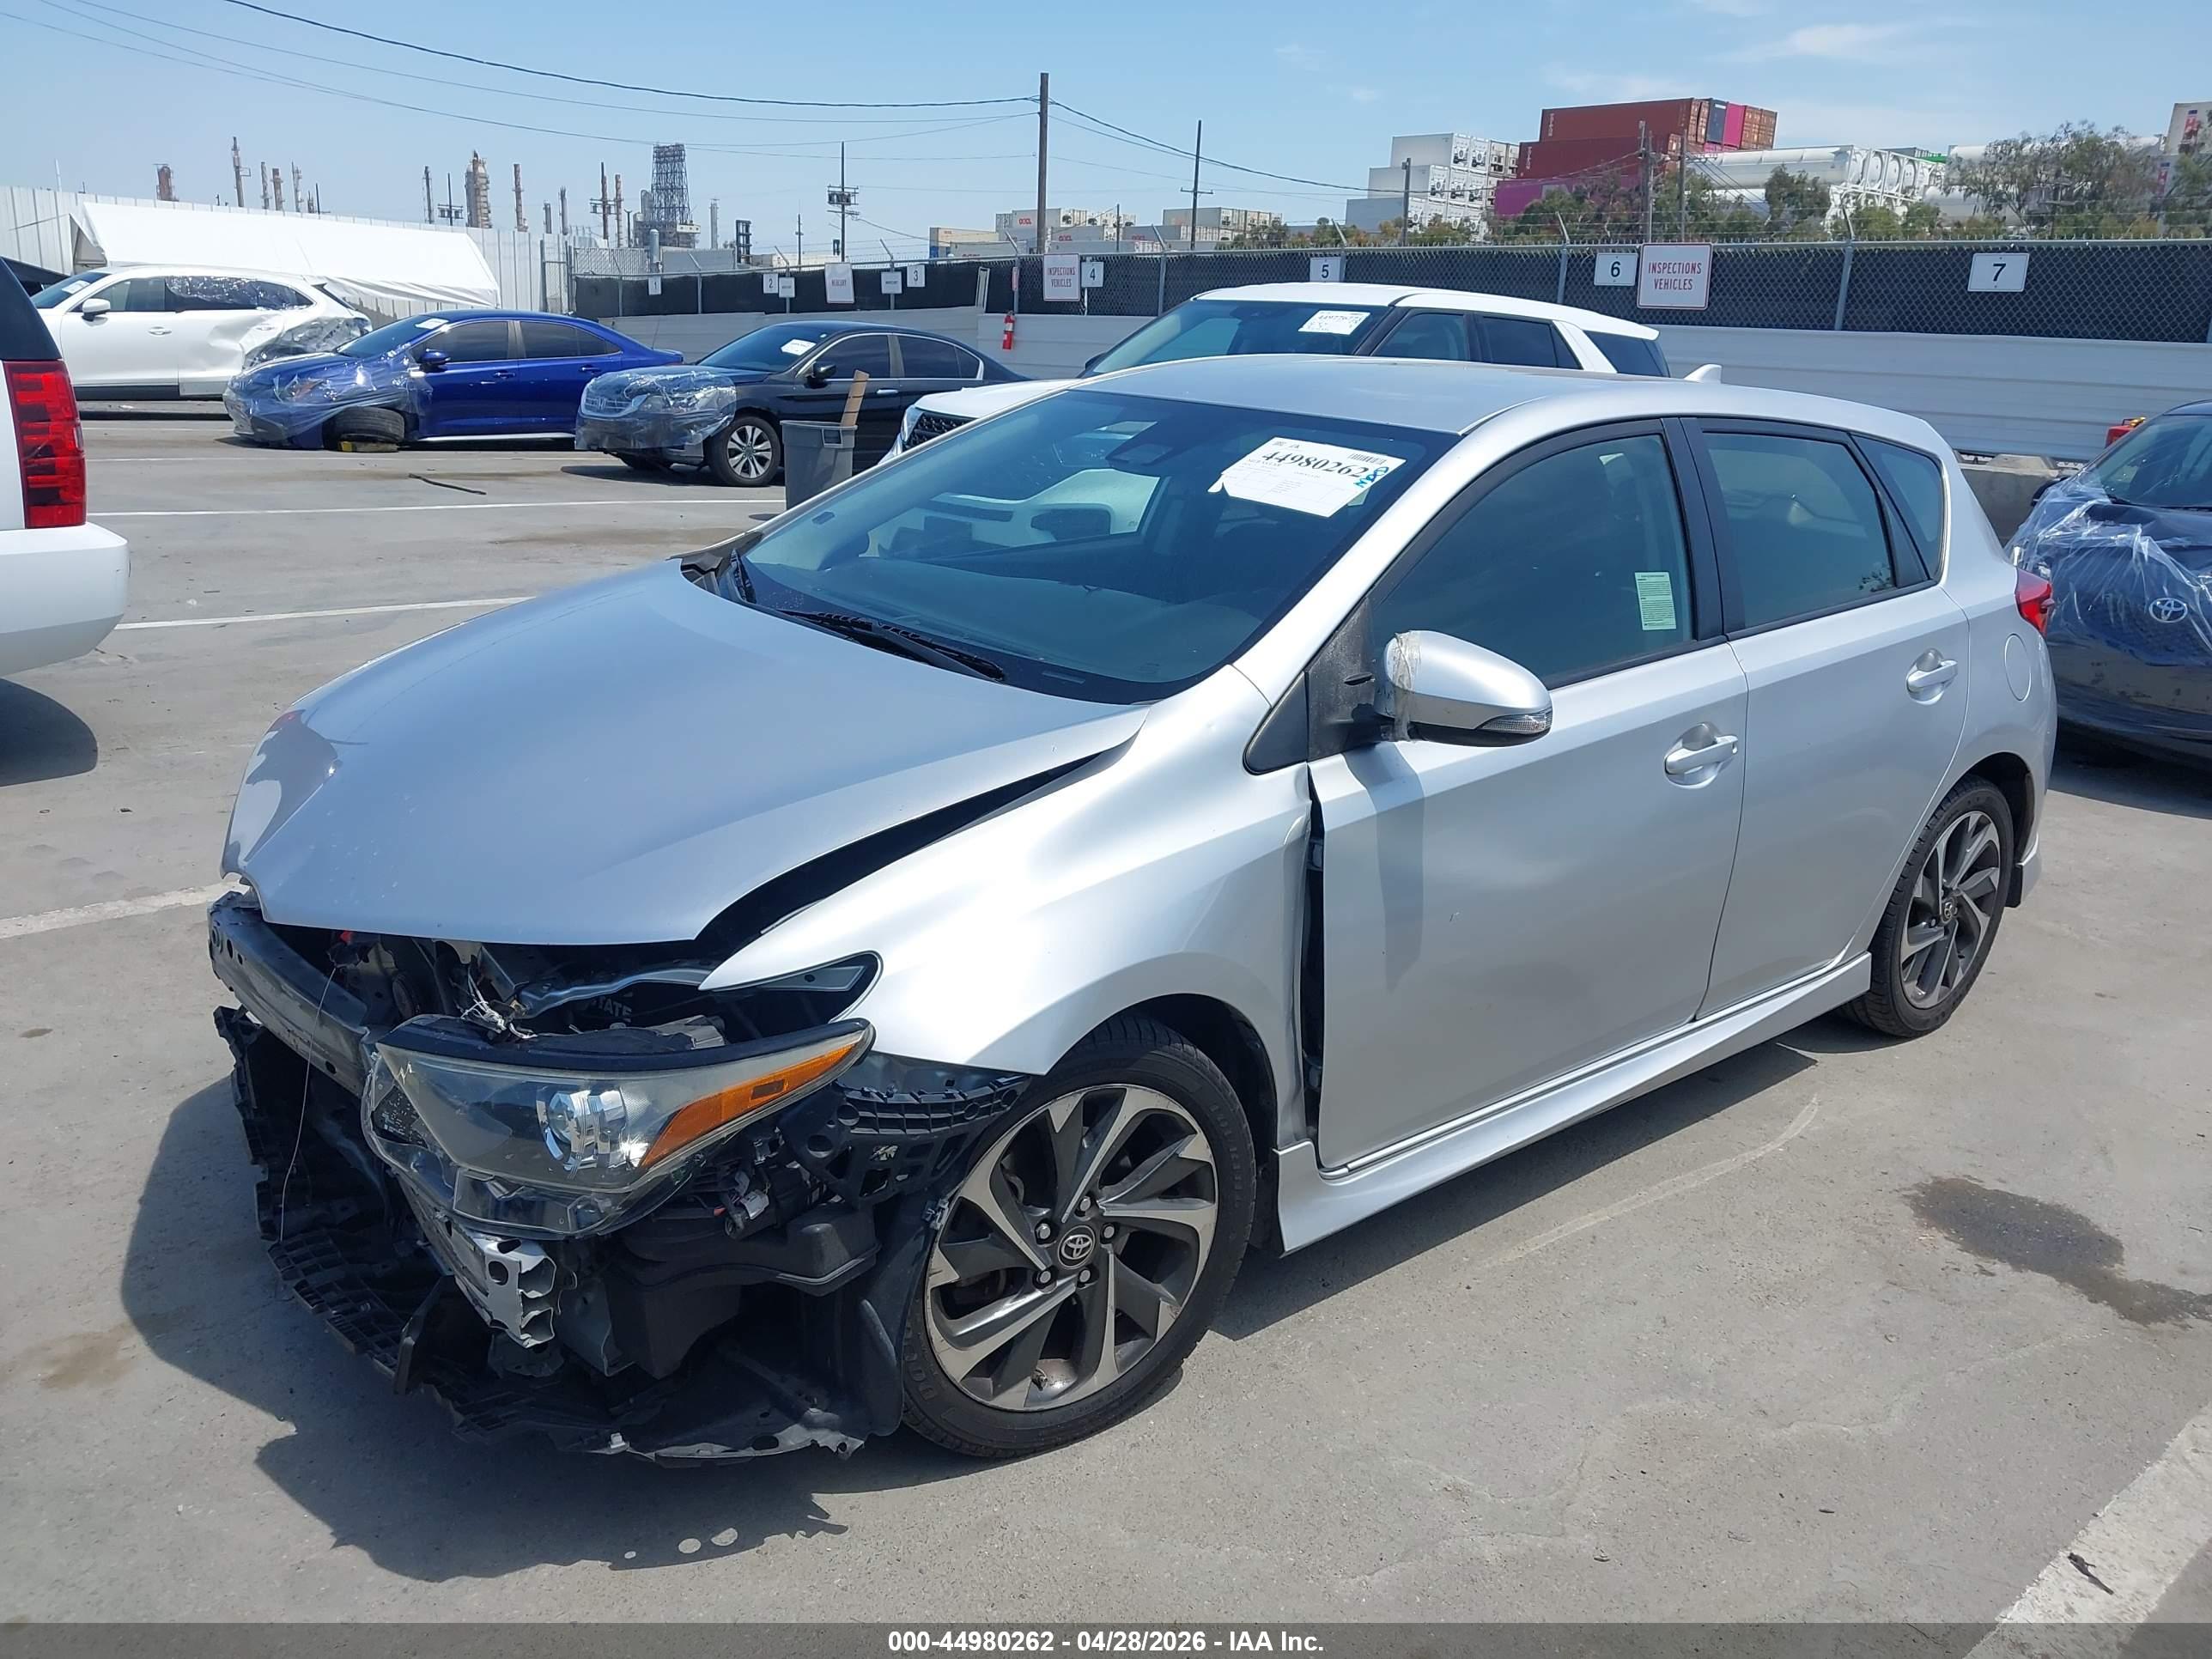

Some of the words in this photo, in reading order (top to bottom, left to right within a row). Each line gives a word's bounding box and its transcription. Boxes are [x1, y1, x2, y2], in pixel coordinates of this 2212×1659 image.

[1047, 266, 1076, 276] INSPECTIONS
[1090, 267, 1097, 281] 4
[1322, 264, 1329, 278] 5
[1611, 261, 1620, 277] 6
[1649, 262, 1702, 275] INSPECTIONS
[1993, 263, 2007, 282] 7
[914, 270, 919, 283] 3
[1050, 278, 1073, 288] VEHICLES
[769, 278, 774, 289] 2
[1654, 278, 1693, 290] VEHICLES
[1261, 451, 1370, 477] 44980262
